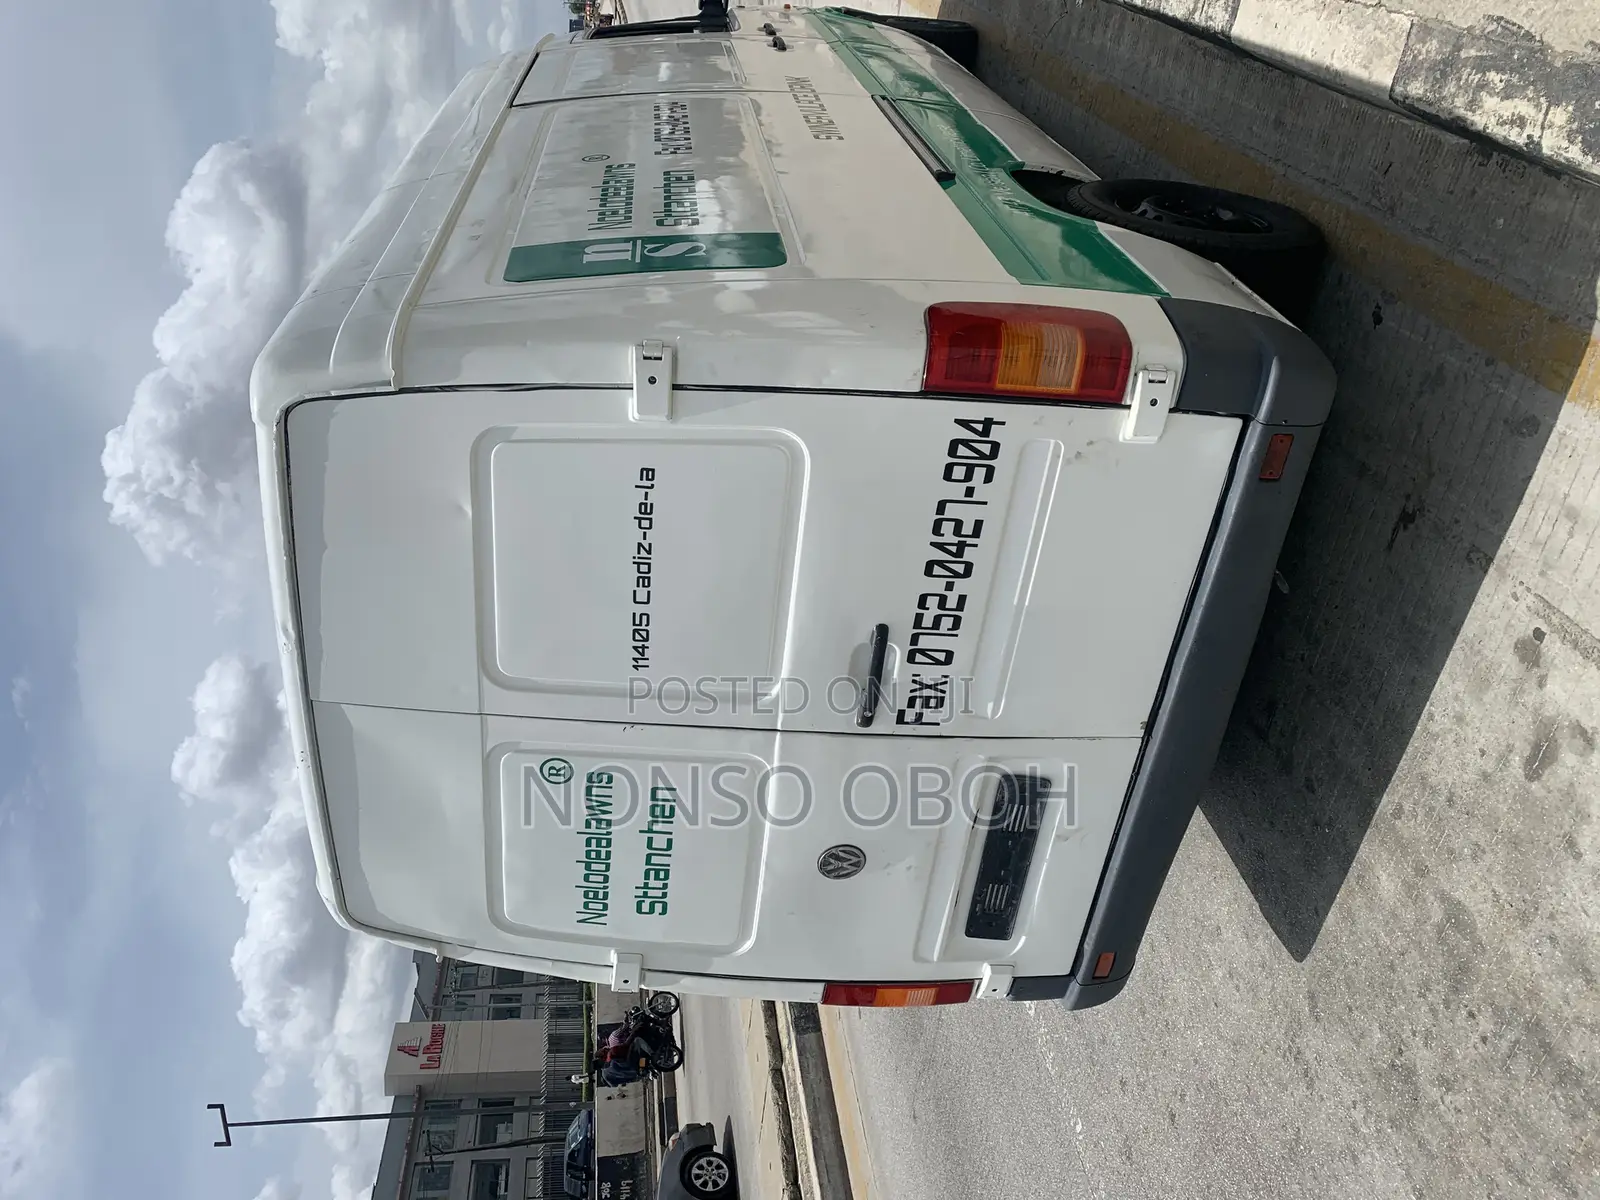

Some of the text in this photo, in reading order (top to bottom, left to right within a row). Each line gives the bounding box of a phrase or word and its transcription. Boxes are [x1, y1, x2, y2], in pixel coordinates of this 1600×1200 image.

[632, 467, 656, 672] 11405 Cadiz-de-la
[895, 418, 1006, 726] Fax: 0752-0427-904
[576, 771, 614, 926] Noelodealawns
[635, 786, 677, 916] Sttanchen
